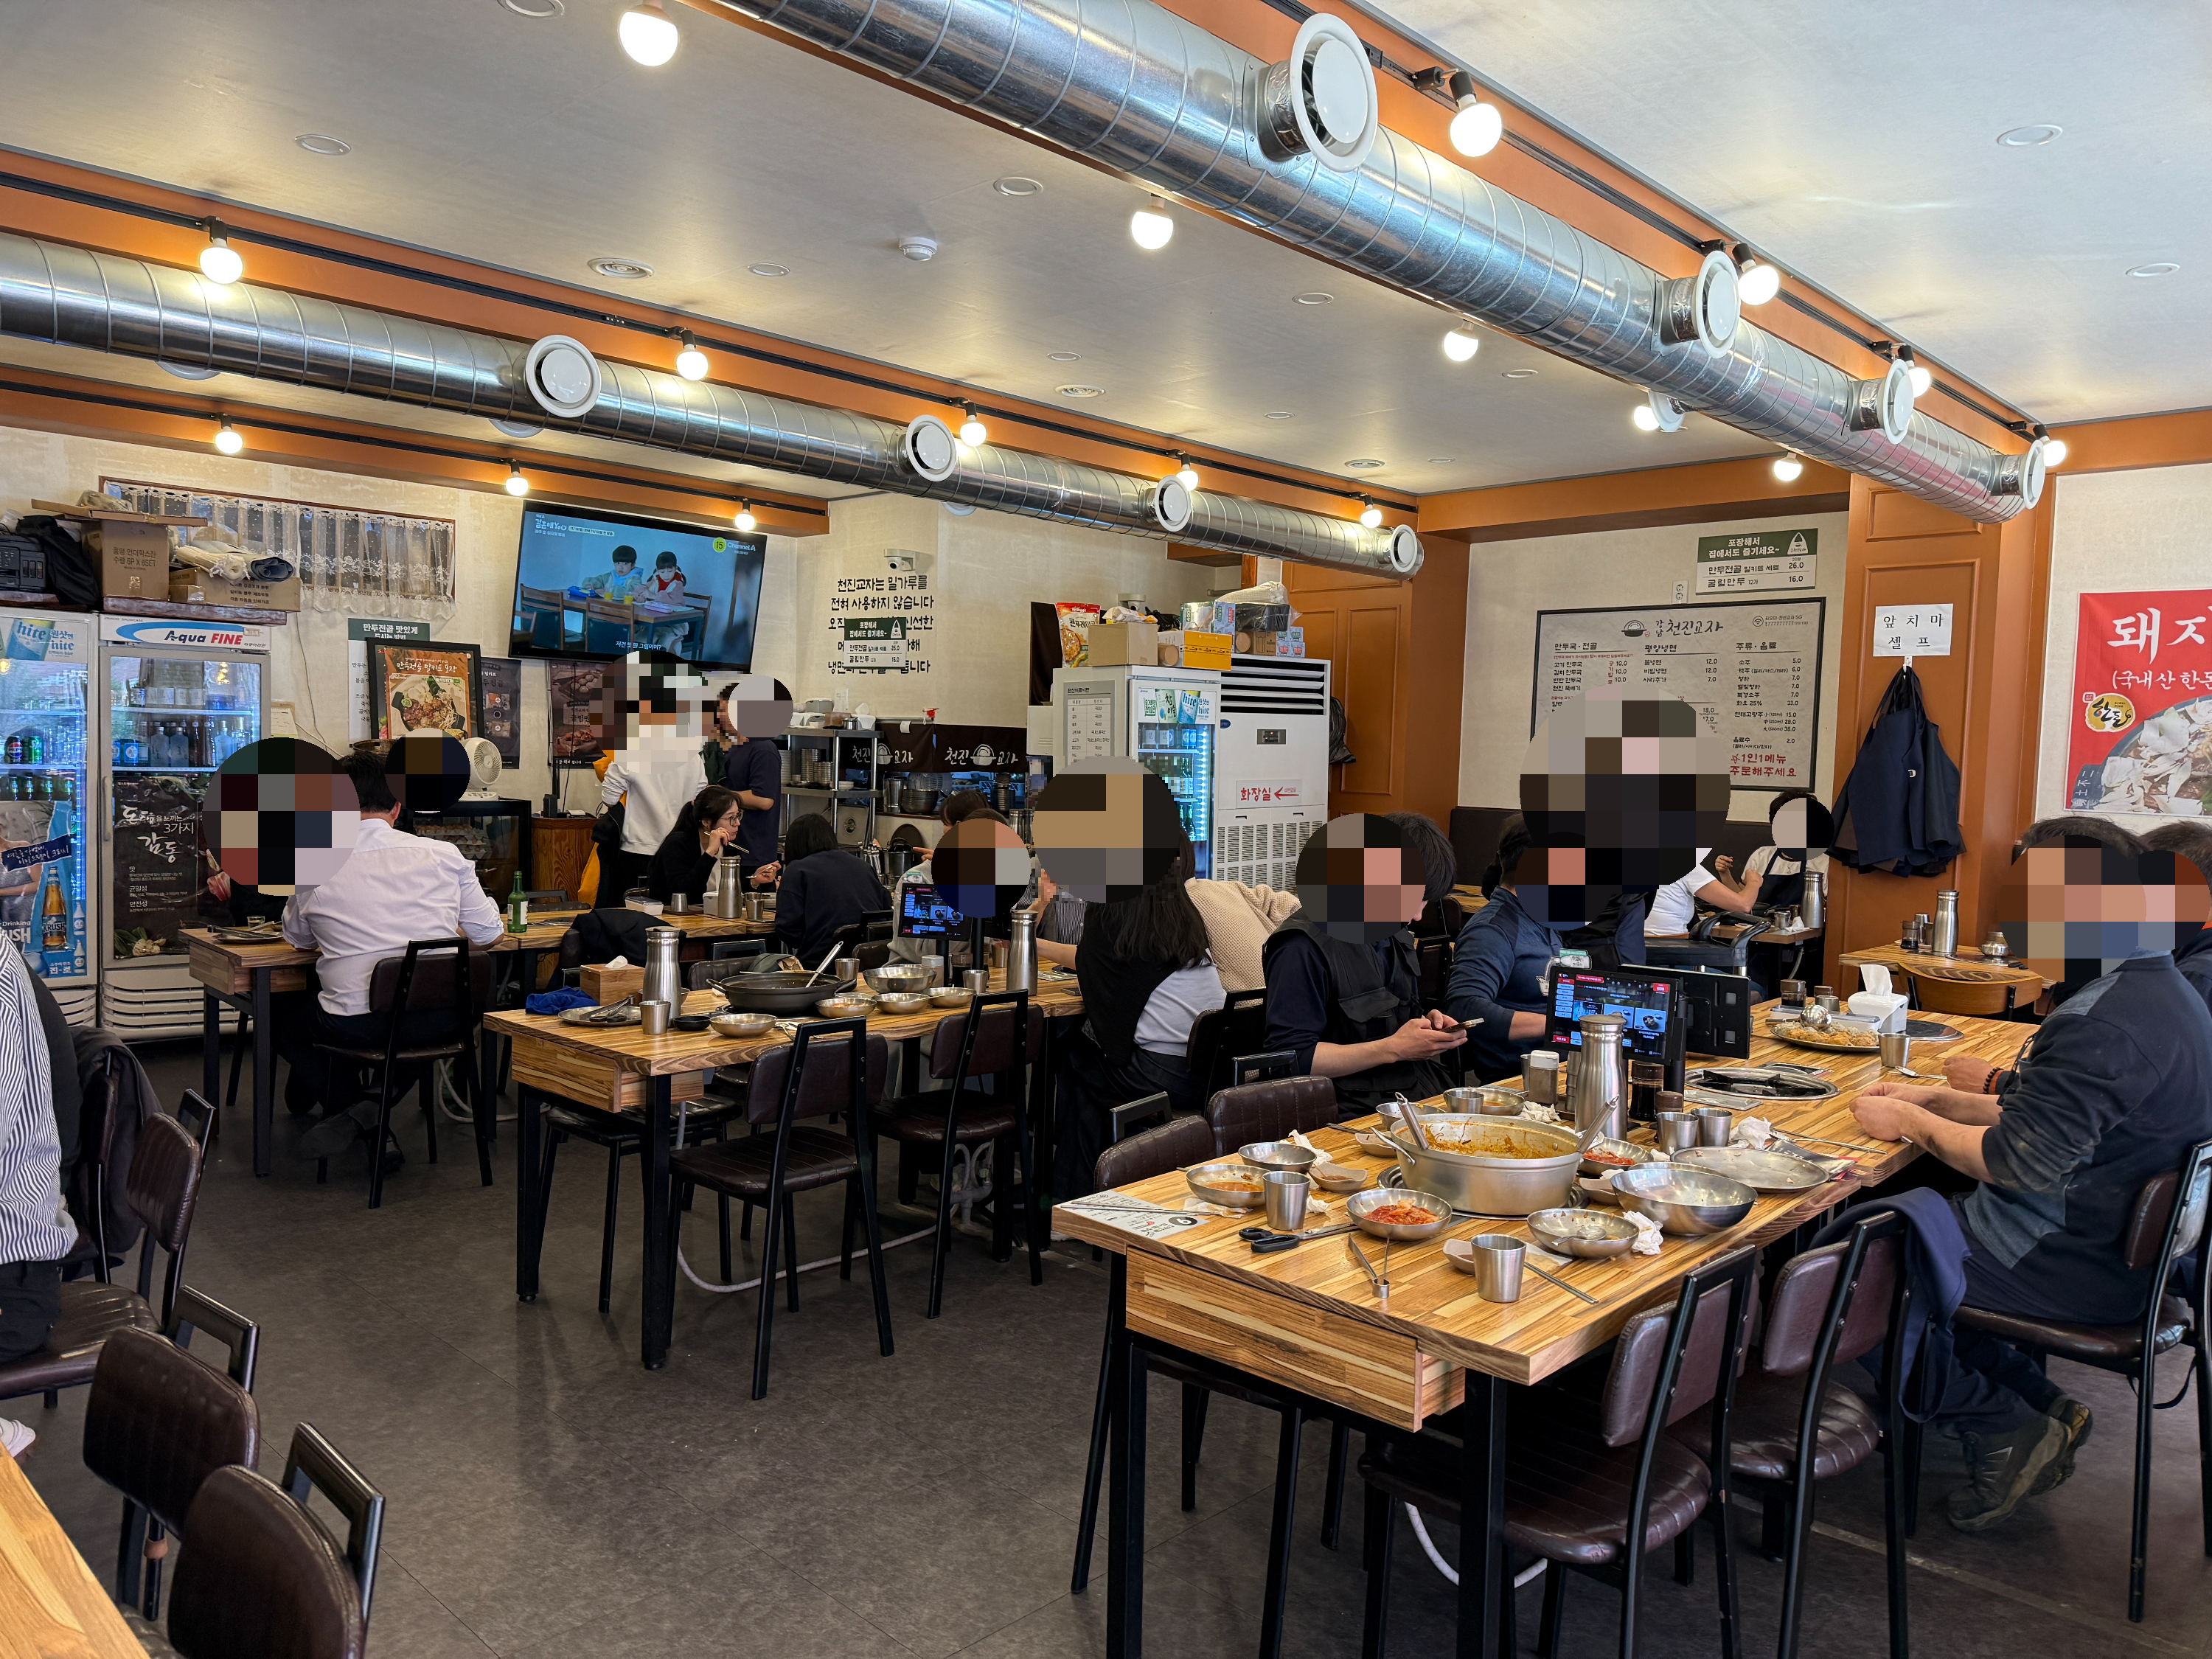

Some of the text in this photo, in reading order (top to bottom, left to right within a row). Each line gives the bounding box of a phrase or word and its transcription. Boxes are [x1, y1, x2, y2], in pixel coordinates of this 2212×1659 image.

[716, 541, 723, 549] 15
[1728, 537, 1760, 547] 포장해서
[1708, 548, 1740, 558] 집에서도
[1708, 565, 1742, 575] 만두전골
[1789, 562, 1804, 570] 26.0
[838, 575, 928, 592] 천진교자는 밀가루를
[1708, 577, 1745, 588] 굴림만두
[831, 595, 934, 611] 전혀 사용하지 않습니다
[17, 622, 46, 640] hite
[363, 623, 418, 635] 만두전골 맛있게
[164, 630, 243, 645] Aqua FINE
[51, 639, 74, 650] hite
[1644, 644, 1677, 653] 평양냉면
[1183, 692, 1197, 707] hite
[1198, 706, 1210, 714] hite
[852, 745, 914, 765] 천진 교자
[945, 746, 1018, 766] 천진 교자
[1730, 765, 1797, 776] 주문해주세요
[1240, 787, 1271, 802] 화장실
[163, 822, 194, 835] 3가지
[137, 832, 184, 863] 감동
[43, 922, 65, 934] KRUSH
